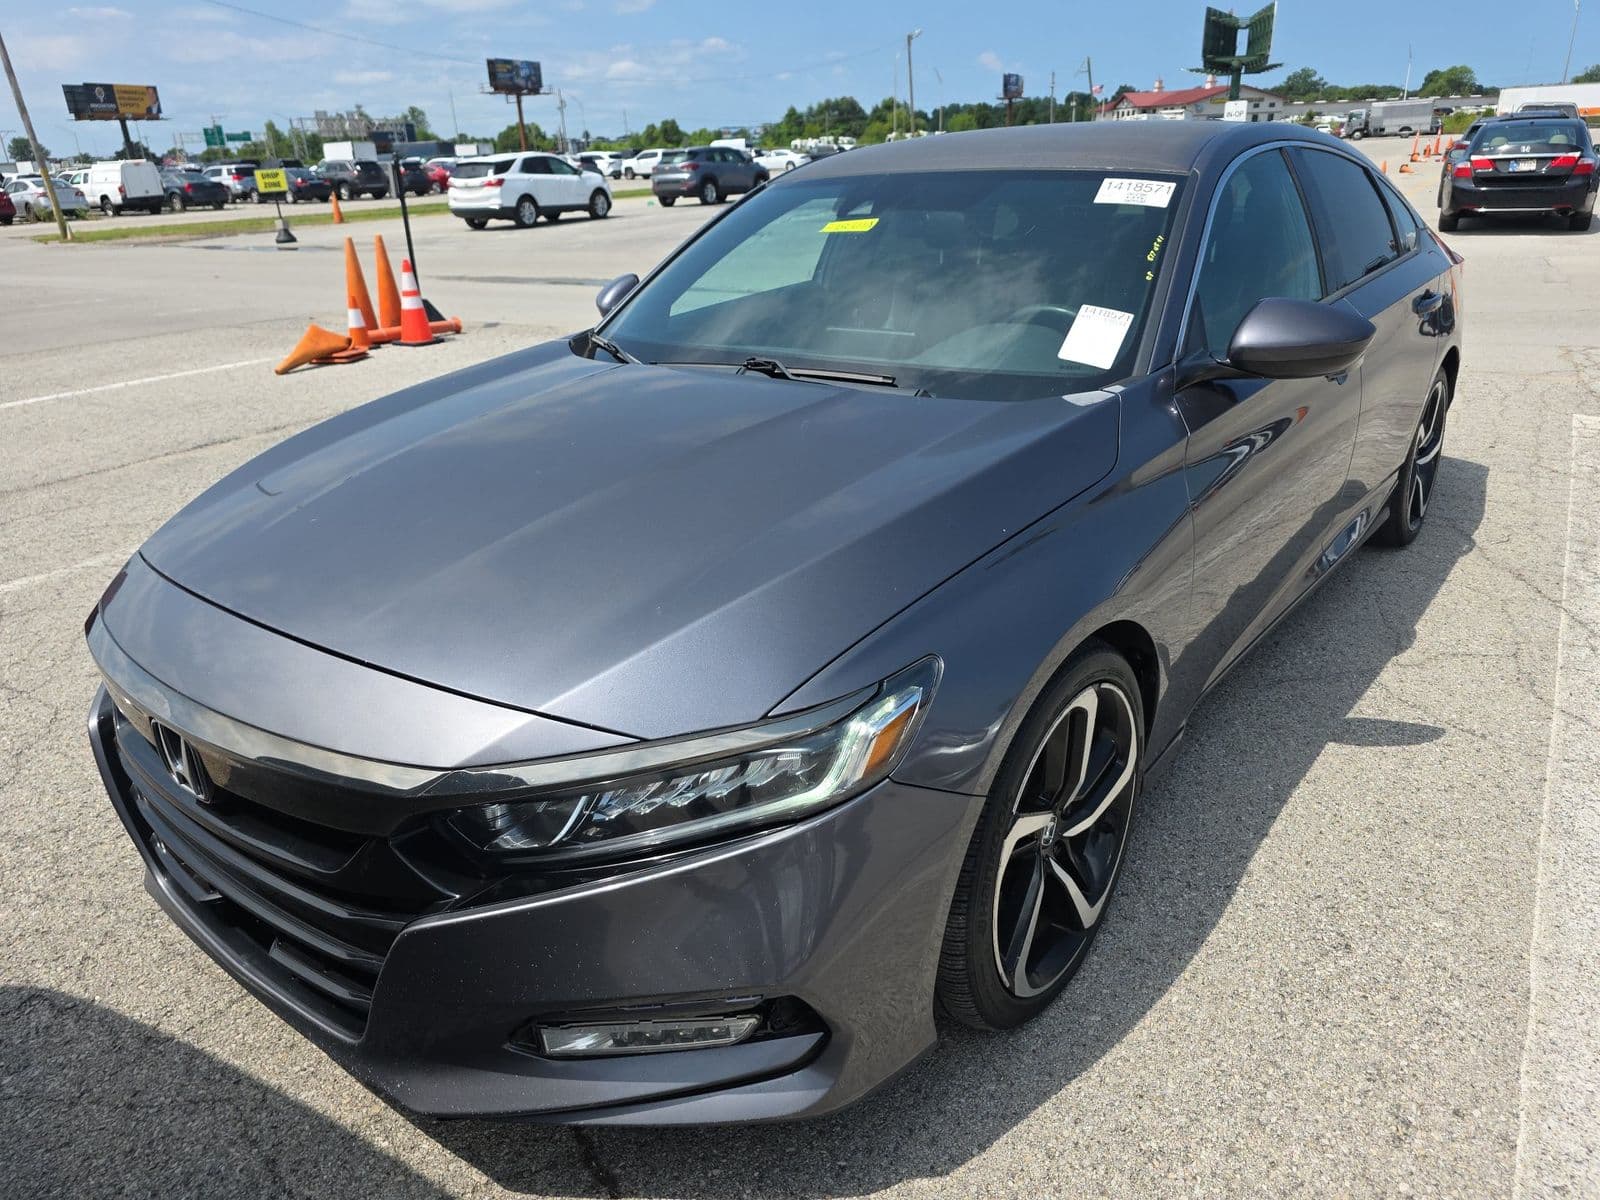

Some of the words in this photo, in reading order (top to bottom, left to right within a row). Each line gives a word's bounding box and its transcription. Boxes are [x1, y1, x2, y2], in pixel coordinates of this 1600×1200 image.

[261, 172, 280, 180] DROP
[264, 181, 281, 189] ZONE
[1106, 181, 1172, 195] 1418571
